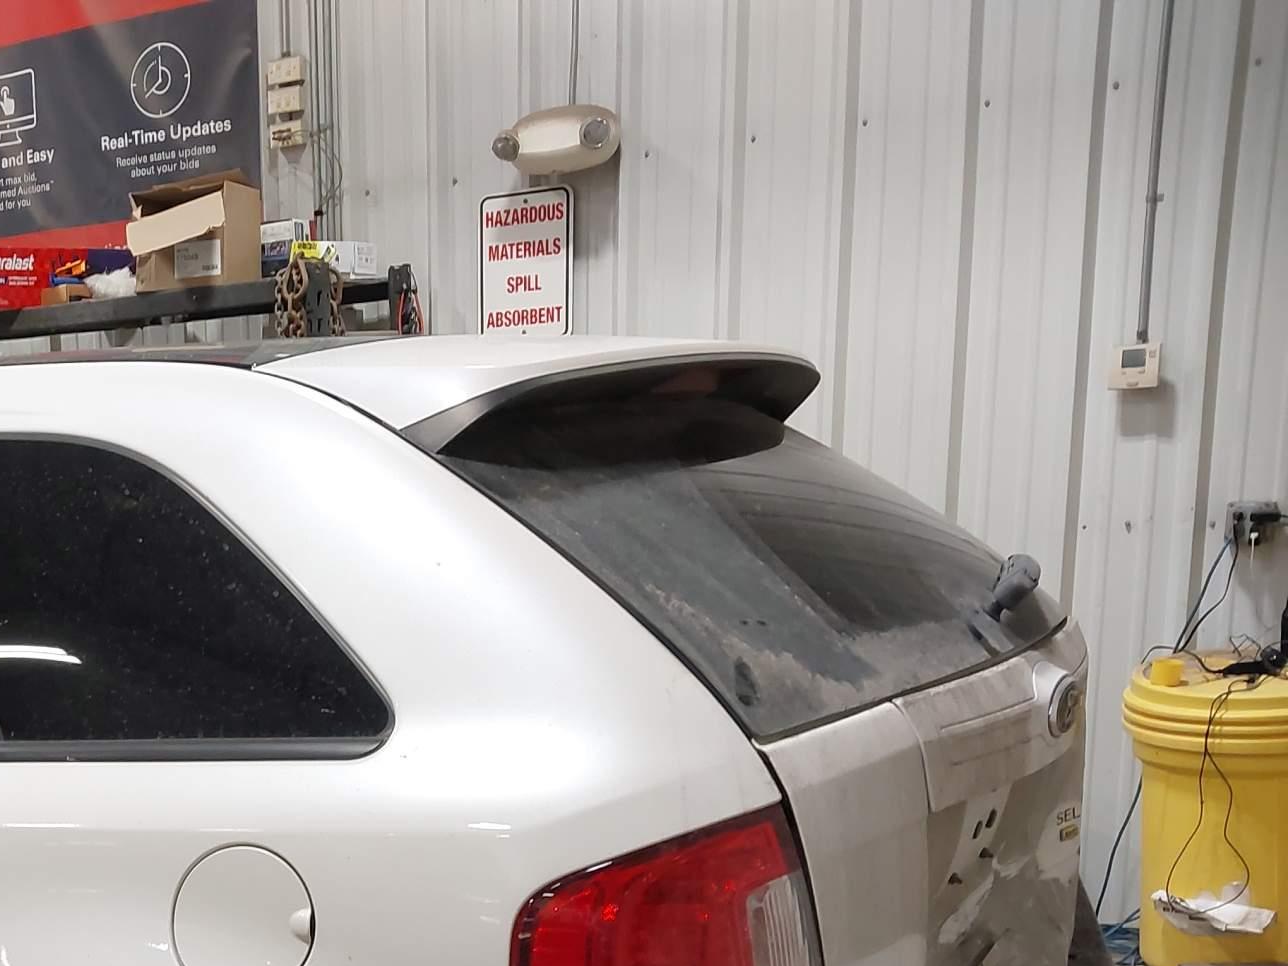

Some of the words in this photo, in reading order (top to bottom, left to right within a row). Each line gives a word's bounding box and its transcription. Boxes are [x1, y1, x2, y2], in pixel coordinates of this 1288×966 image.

[101, 129, 166, 152] Real-Time
[170, 119, 232, 141] Updates
[1, 151, 24, 169] and
[26, 148, 55, 165] Easy
[116, 153, 147, 168] Receive
[149, 150, 176, 162] status
[178, 144, 216, 159] updates
[130, 165, 154, 178] about
[156, 162, 178, 176] your
[179, 159, 200, 170] bids
[5, 175, 22, 186] max
[5, 199, 15, 210] for
[17, 198, 32, 211] you
[485, 202, 564, 229] HAZARDOUS
[488, 237, 561, 262] MATERIALS
[506, 274, 542, 294] SPILL
[486, 306, 562, 329] ABSORBENT
[1056, 807, 1081, 826] SEL
